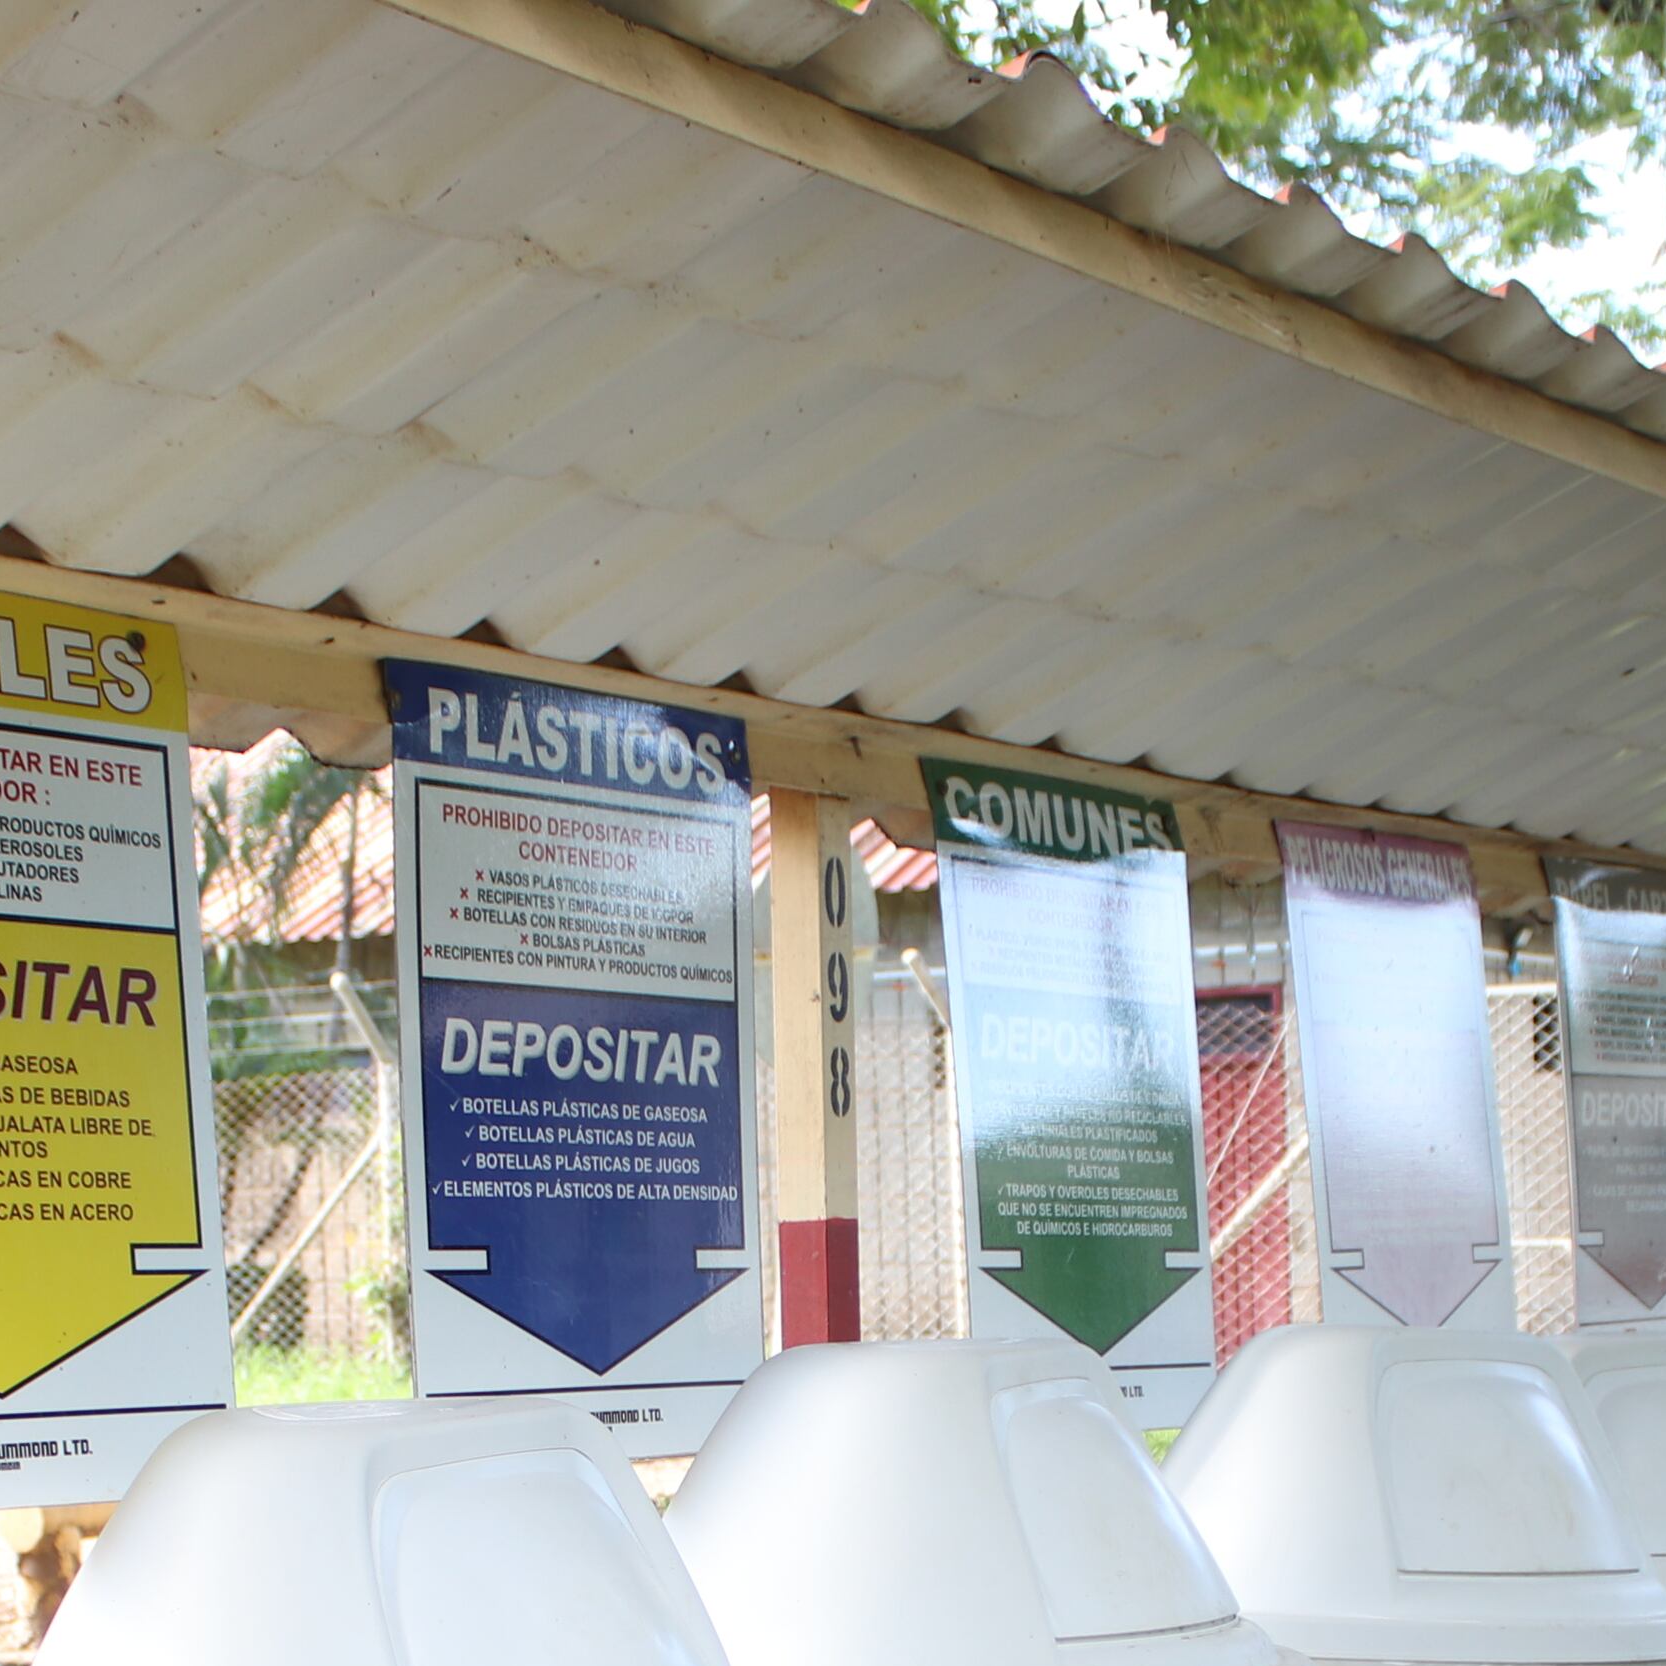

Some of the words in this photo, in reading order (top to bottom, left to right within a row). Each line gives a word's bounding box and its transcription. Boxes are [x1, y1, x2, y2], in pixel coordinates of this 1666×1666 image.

[428, 686, 726, 794] PLÁSTICOS
[49, 753, 78, 780] EN
[86, 758, 141, 787] ESTE
[945, 776, 1173, 853] COMUNES
[89, 824, 161, 849] QUÍMICOS
[442, 804, 541, 834] PROHIBIDO
[547, 816, 642, 847] DEPOSITAR
[648, 829, 667, 850] EN
[675, 832, 715, 856] ESTE
[519, 842, 637, 872] CONTENEDOR
[464, 908, 526, 928] BOTELLAS
[531, 914, 556, 931] CON
[559, 916, 617, 937] RESIDUOS
[621, 921, 635, 938] EN
[639, 923, 653, 939] SU
[656, 925, 706, 944] INTERIOR
[534, 934, 580, 952] BOLSAS
[583, 937, 645, 956] PLÁSTICAS
[435, 945, 513, 965] RECIPIENTES
[518, 950, 542, 967] CON
[546, 953, 597, 972] PINTURA
[599, 957, 606, 973] Y
[609, 958, 678, 979] PRODUCTOS
[681, 964, 733, 983] QUÍMICOS
[441, 1017, 721, 1087] DEPOSITAR
[20, 1082, 46, 1106] DE
[51, 1084, 130, 1107] BEBIDAS
[463, 1098, 539, 1116] BOTELLAS
[543, 1100, 618, 1120] PLÁSTICAS
[623, 1103, 641, 1121] DE
[644, 1104, 707, 1123] GASEOSA
[71, 1117, 122, 1136] LIBRE
[444, 1180, 532, 1197] ELEMENTOS
[536, 1180, 613, 1199] PLÁSTICOS
[617, 1182, 634, 1200] DE
[638, 1182, 669, 1200] ALTA
[673, 1184, 738, 1201] DENSIDAD
[1006, 1184, 1046, 1197] TRAPOS
[1049, 1185, 1056, 1198] Y
[1058, 1185, 1108, 1200] OVEROLES
[1111, 1186, 1178, 1201] DESECHABLES
[41, 1203, 65, 1220] EN
[70, 1203, 133, 1220] ACERO
[63, 1438, 93, 1457] LTD.
